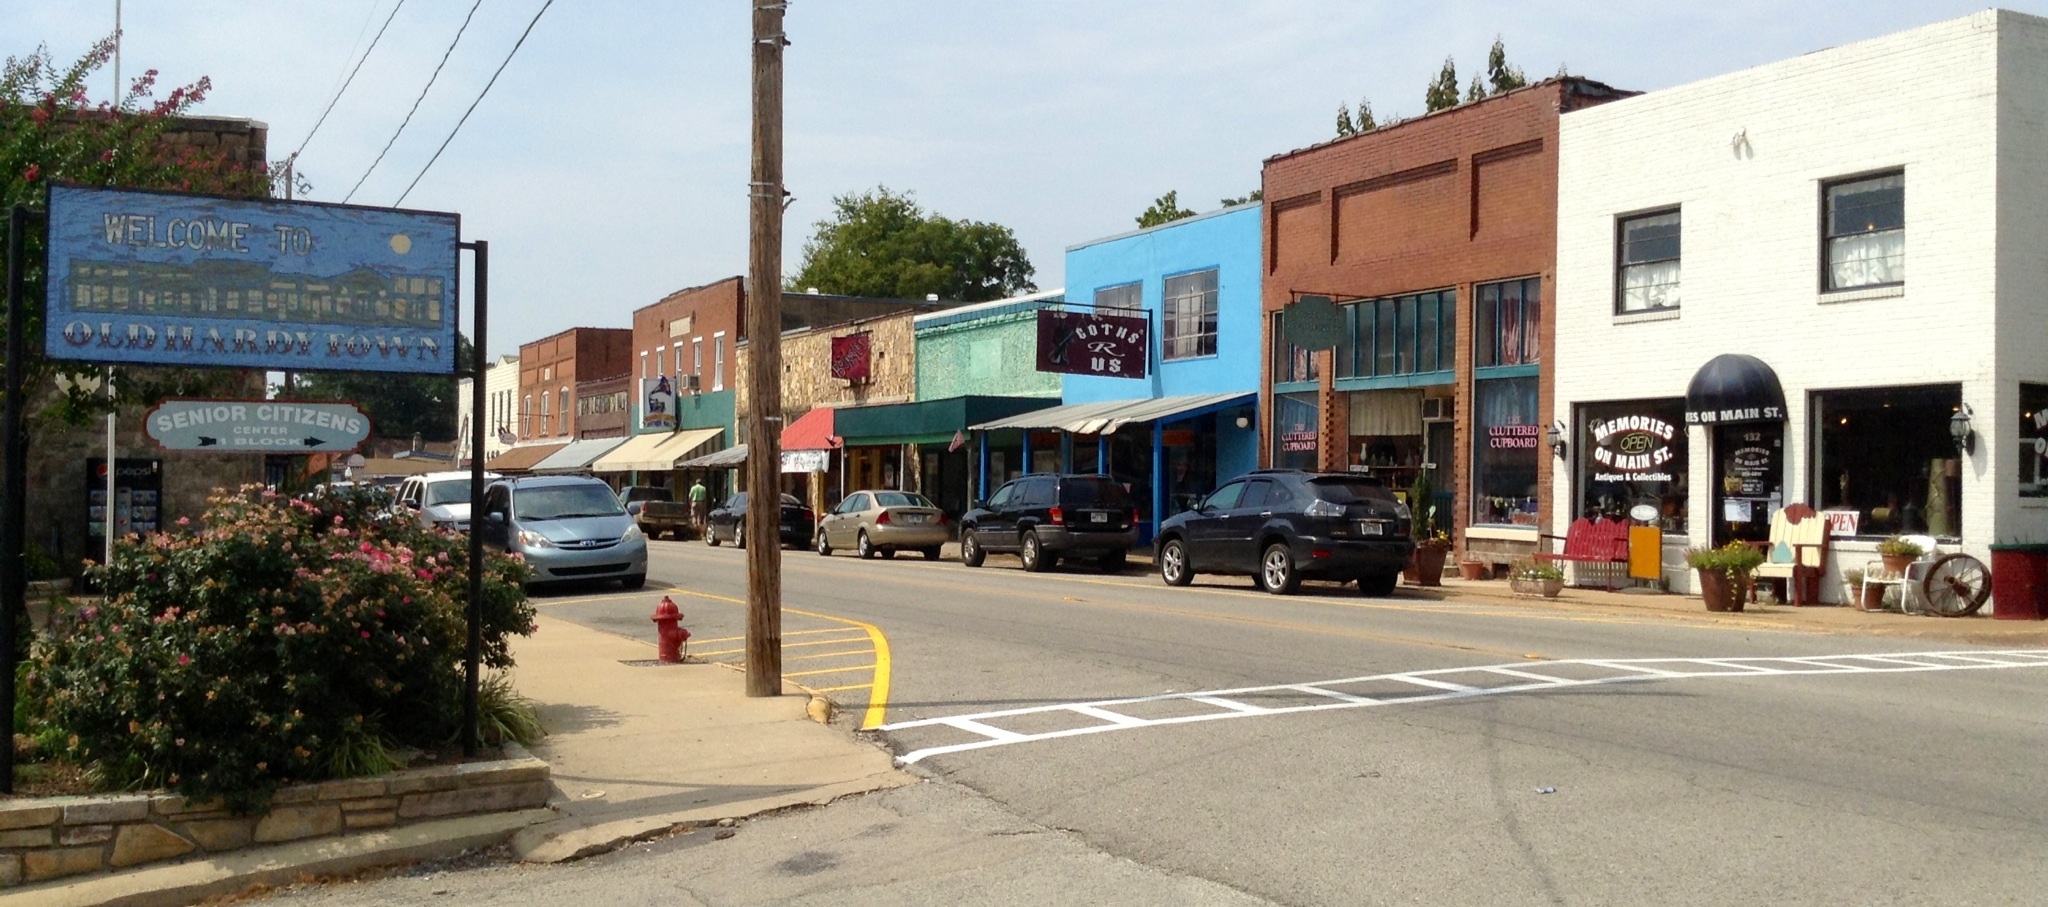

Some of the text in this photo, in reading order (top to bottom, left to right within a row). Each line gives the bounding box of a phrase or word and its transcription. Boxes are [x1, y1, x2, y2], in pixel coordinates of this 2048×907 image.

[103, 213, 312, 256] WELCOME TO
[63, 319, 442, 361] OLD HARDY TOWN
[1075, 323, 1139, 344] GOTHS
[1087, 341, 1126, 357] R
[1091, 357, 1121, 373] US
[157, 405, 361, 434] SENIOR CITIZENS
[1701, 411, 1716, 423] ON
[1720, 408, 1759, 421] MAIN
[1763, 407, 1782, 418] ST.
[233, 426, 288, 435] CENTER
[1489, 425, 1538, 436] CLUTTERED
[1594, 415, 1674, 442] MEMORIES
[219, 437, 300, 446] 1 BLOCK
[1282, 431, 1317, 441] CLUTTERED
[1490, 437, 1537, 448] CUPBOARD
[1620, 436, 1654, 450] OPEN
[1744, 432, 1761, 441] 132
[1282, 441, 1316, 451] CUPBOARD
[1595, 446, 1673, 469] ON MAIN ST.
[116, 466, 151, 477] pepsi
[1595, 472, 1672, 483] Antiques & Collectibles
